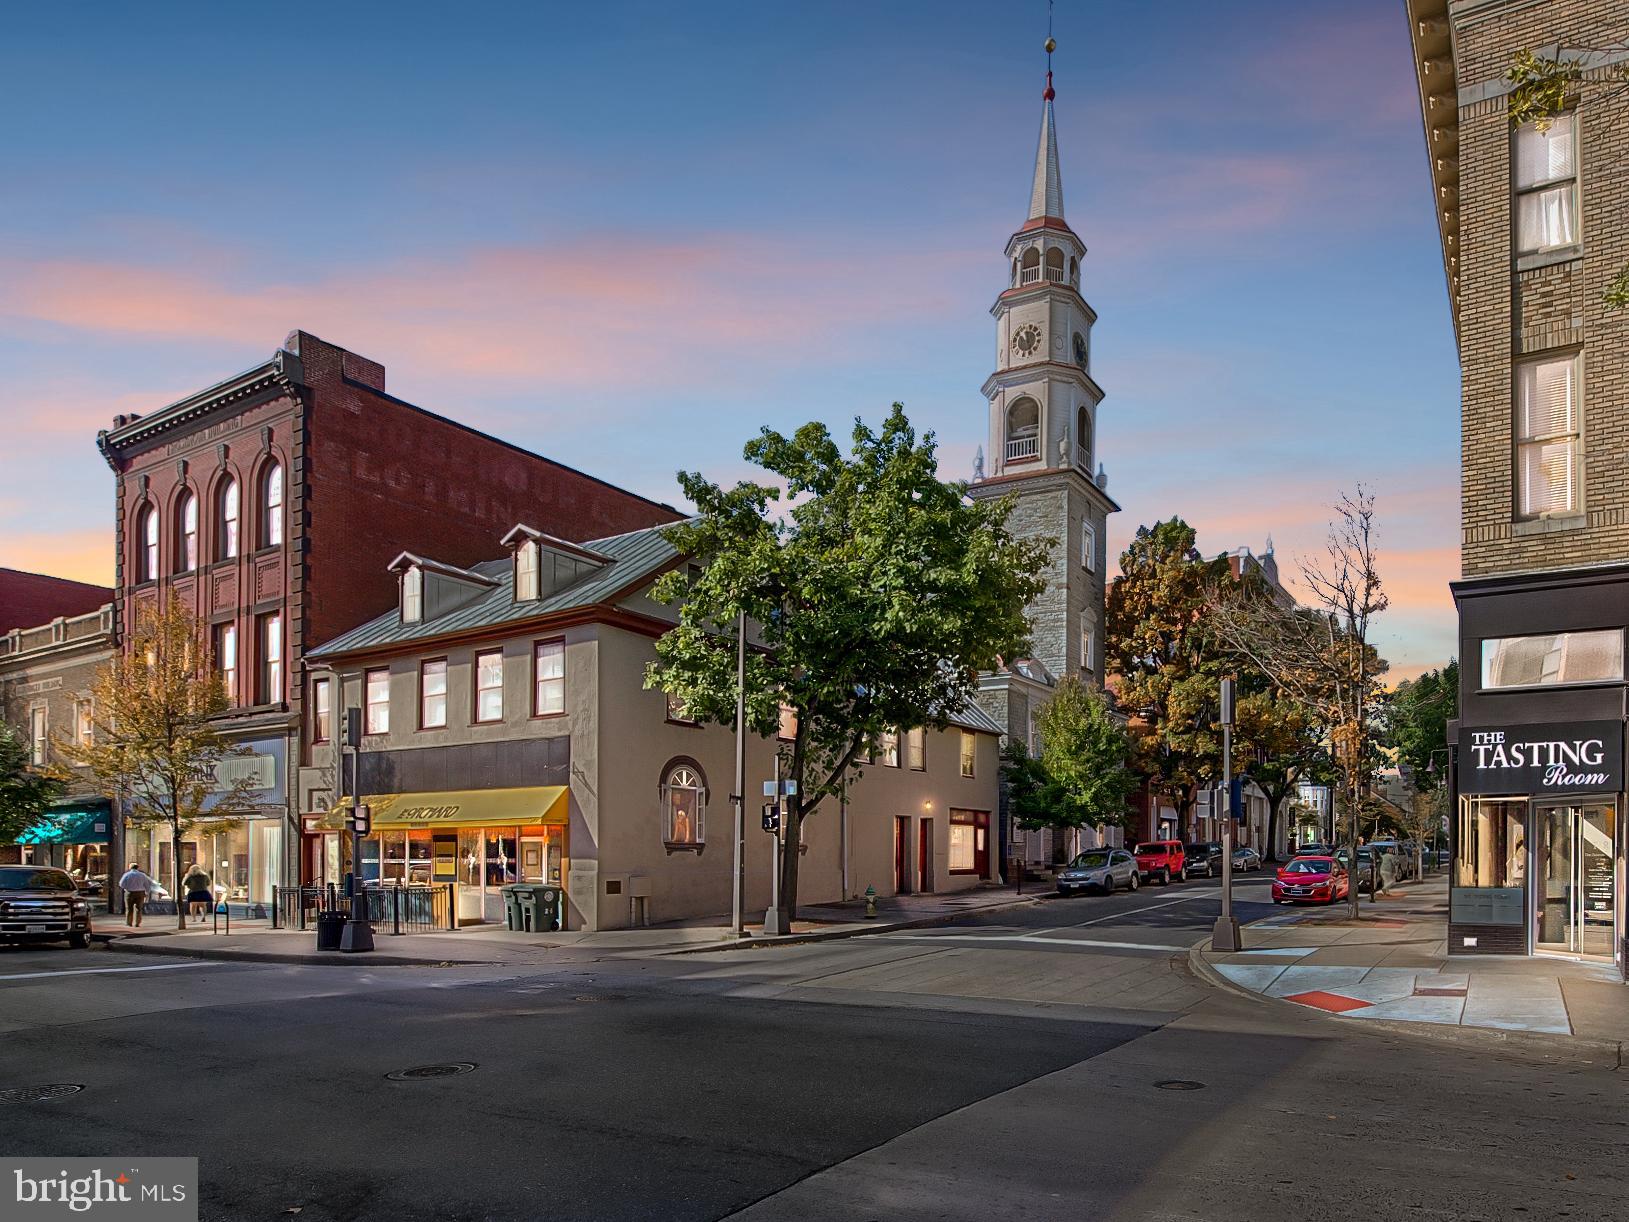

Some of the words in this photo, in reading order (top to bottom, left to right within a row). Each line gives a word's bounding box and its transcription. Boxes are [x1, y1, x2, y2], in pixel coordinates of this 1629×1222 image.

[1472, 732, 1506, 745] THE
[1471, 740, 1605, 769] TASTING
[1543, 764, 1610, 786] Room
[407, 805, 460, 819] ORCHARD
